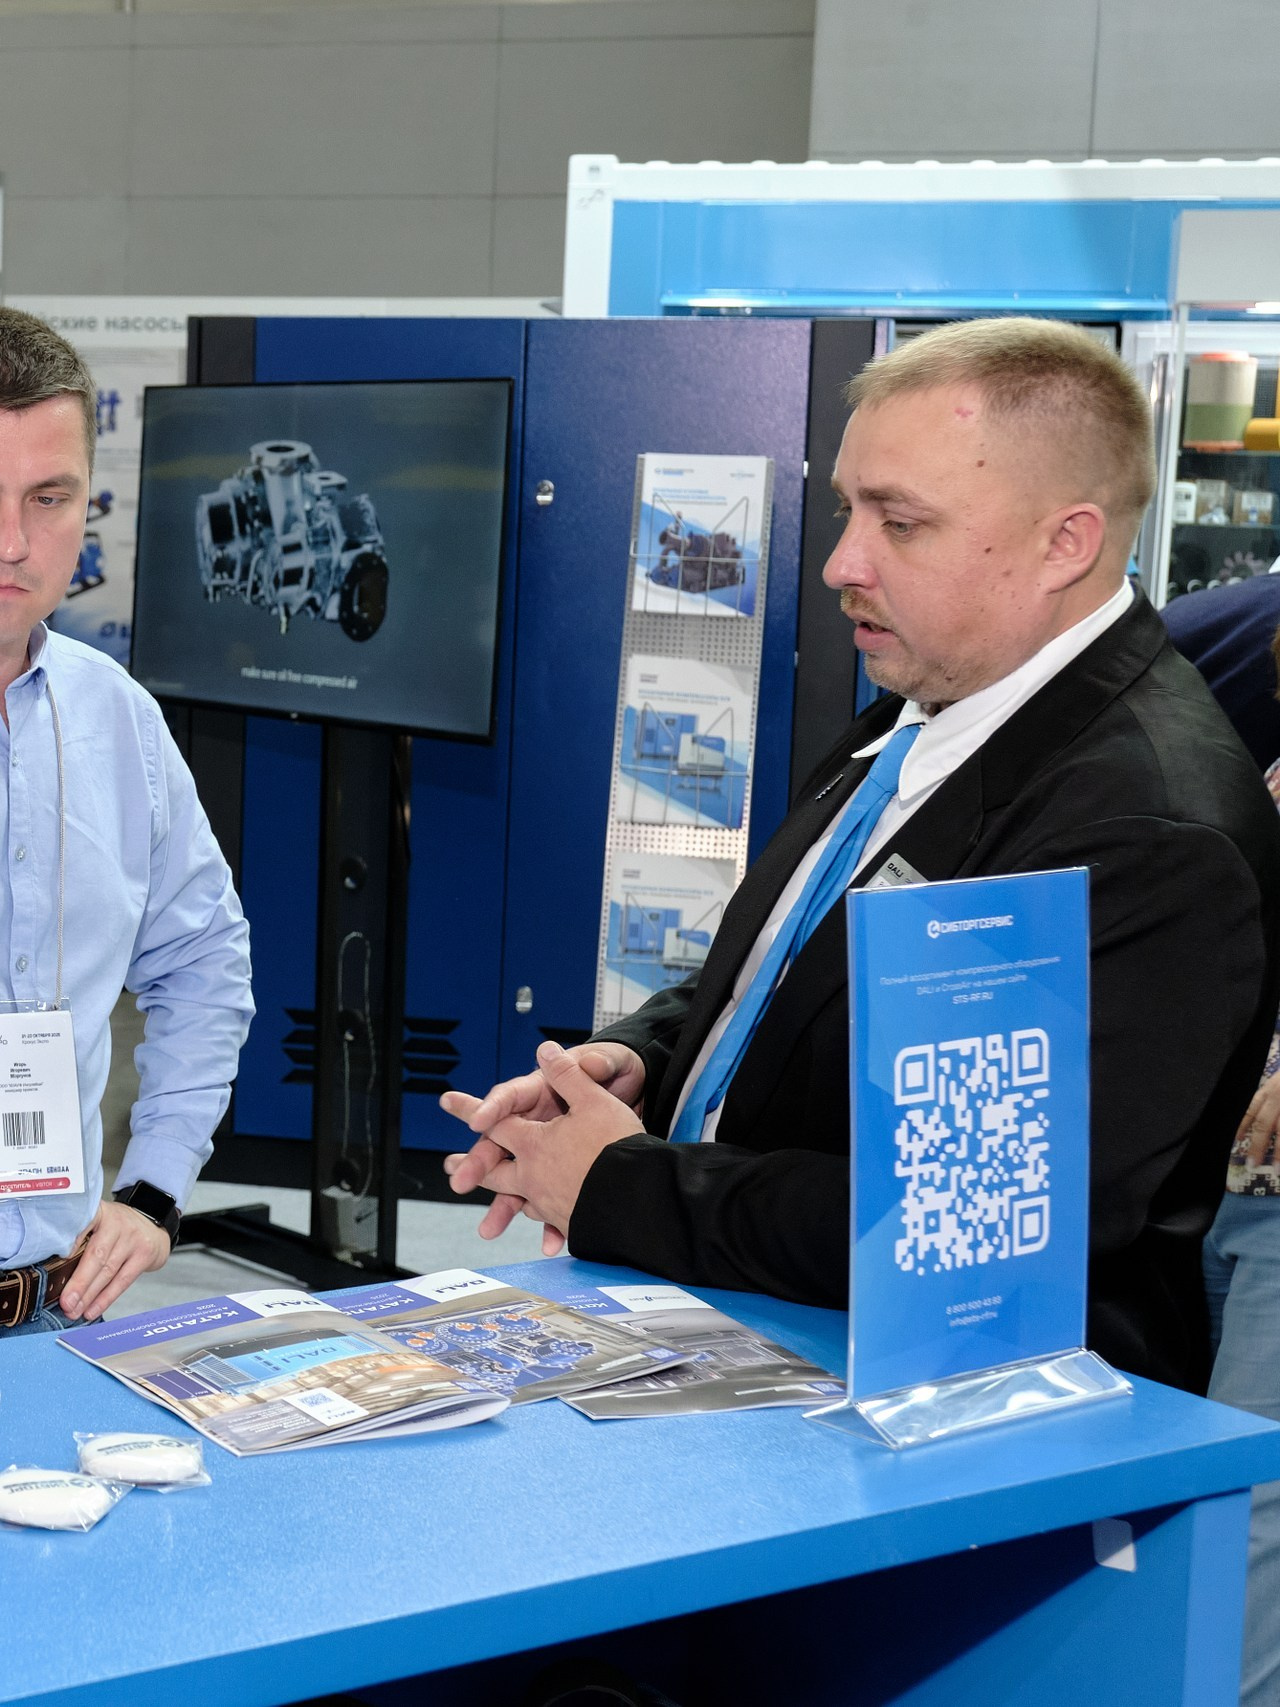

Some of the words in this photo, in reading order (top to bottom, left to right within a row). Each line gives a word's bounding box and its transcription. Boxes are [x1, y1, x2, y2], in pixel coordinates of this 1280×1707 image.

[241, 665, 261, 680] make
[261, 669, 277, 681] sure
[302, 673, 346, 688] compressed
[887, 862, 905, 878] DALI
[431, 1279, 486, 1294] DALI
[143, 1310, 240, 1338] КАТАЛОГ
[281, 1346, 338, 1364] DALI
